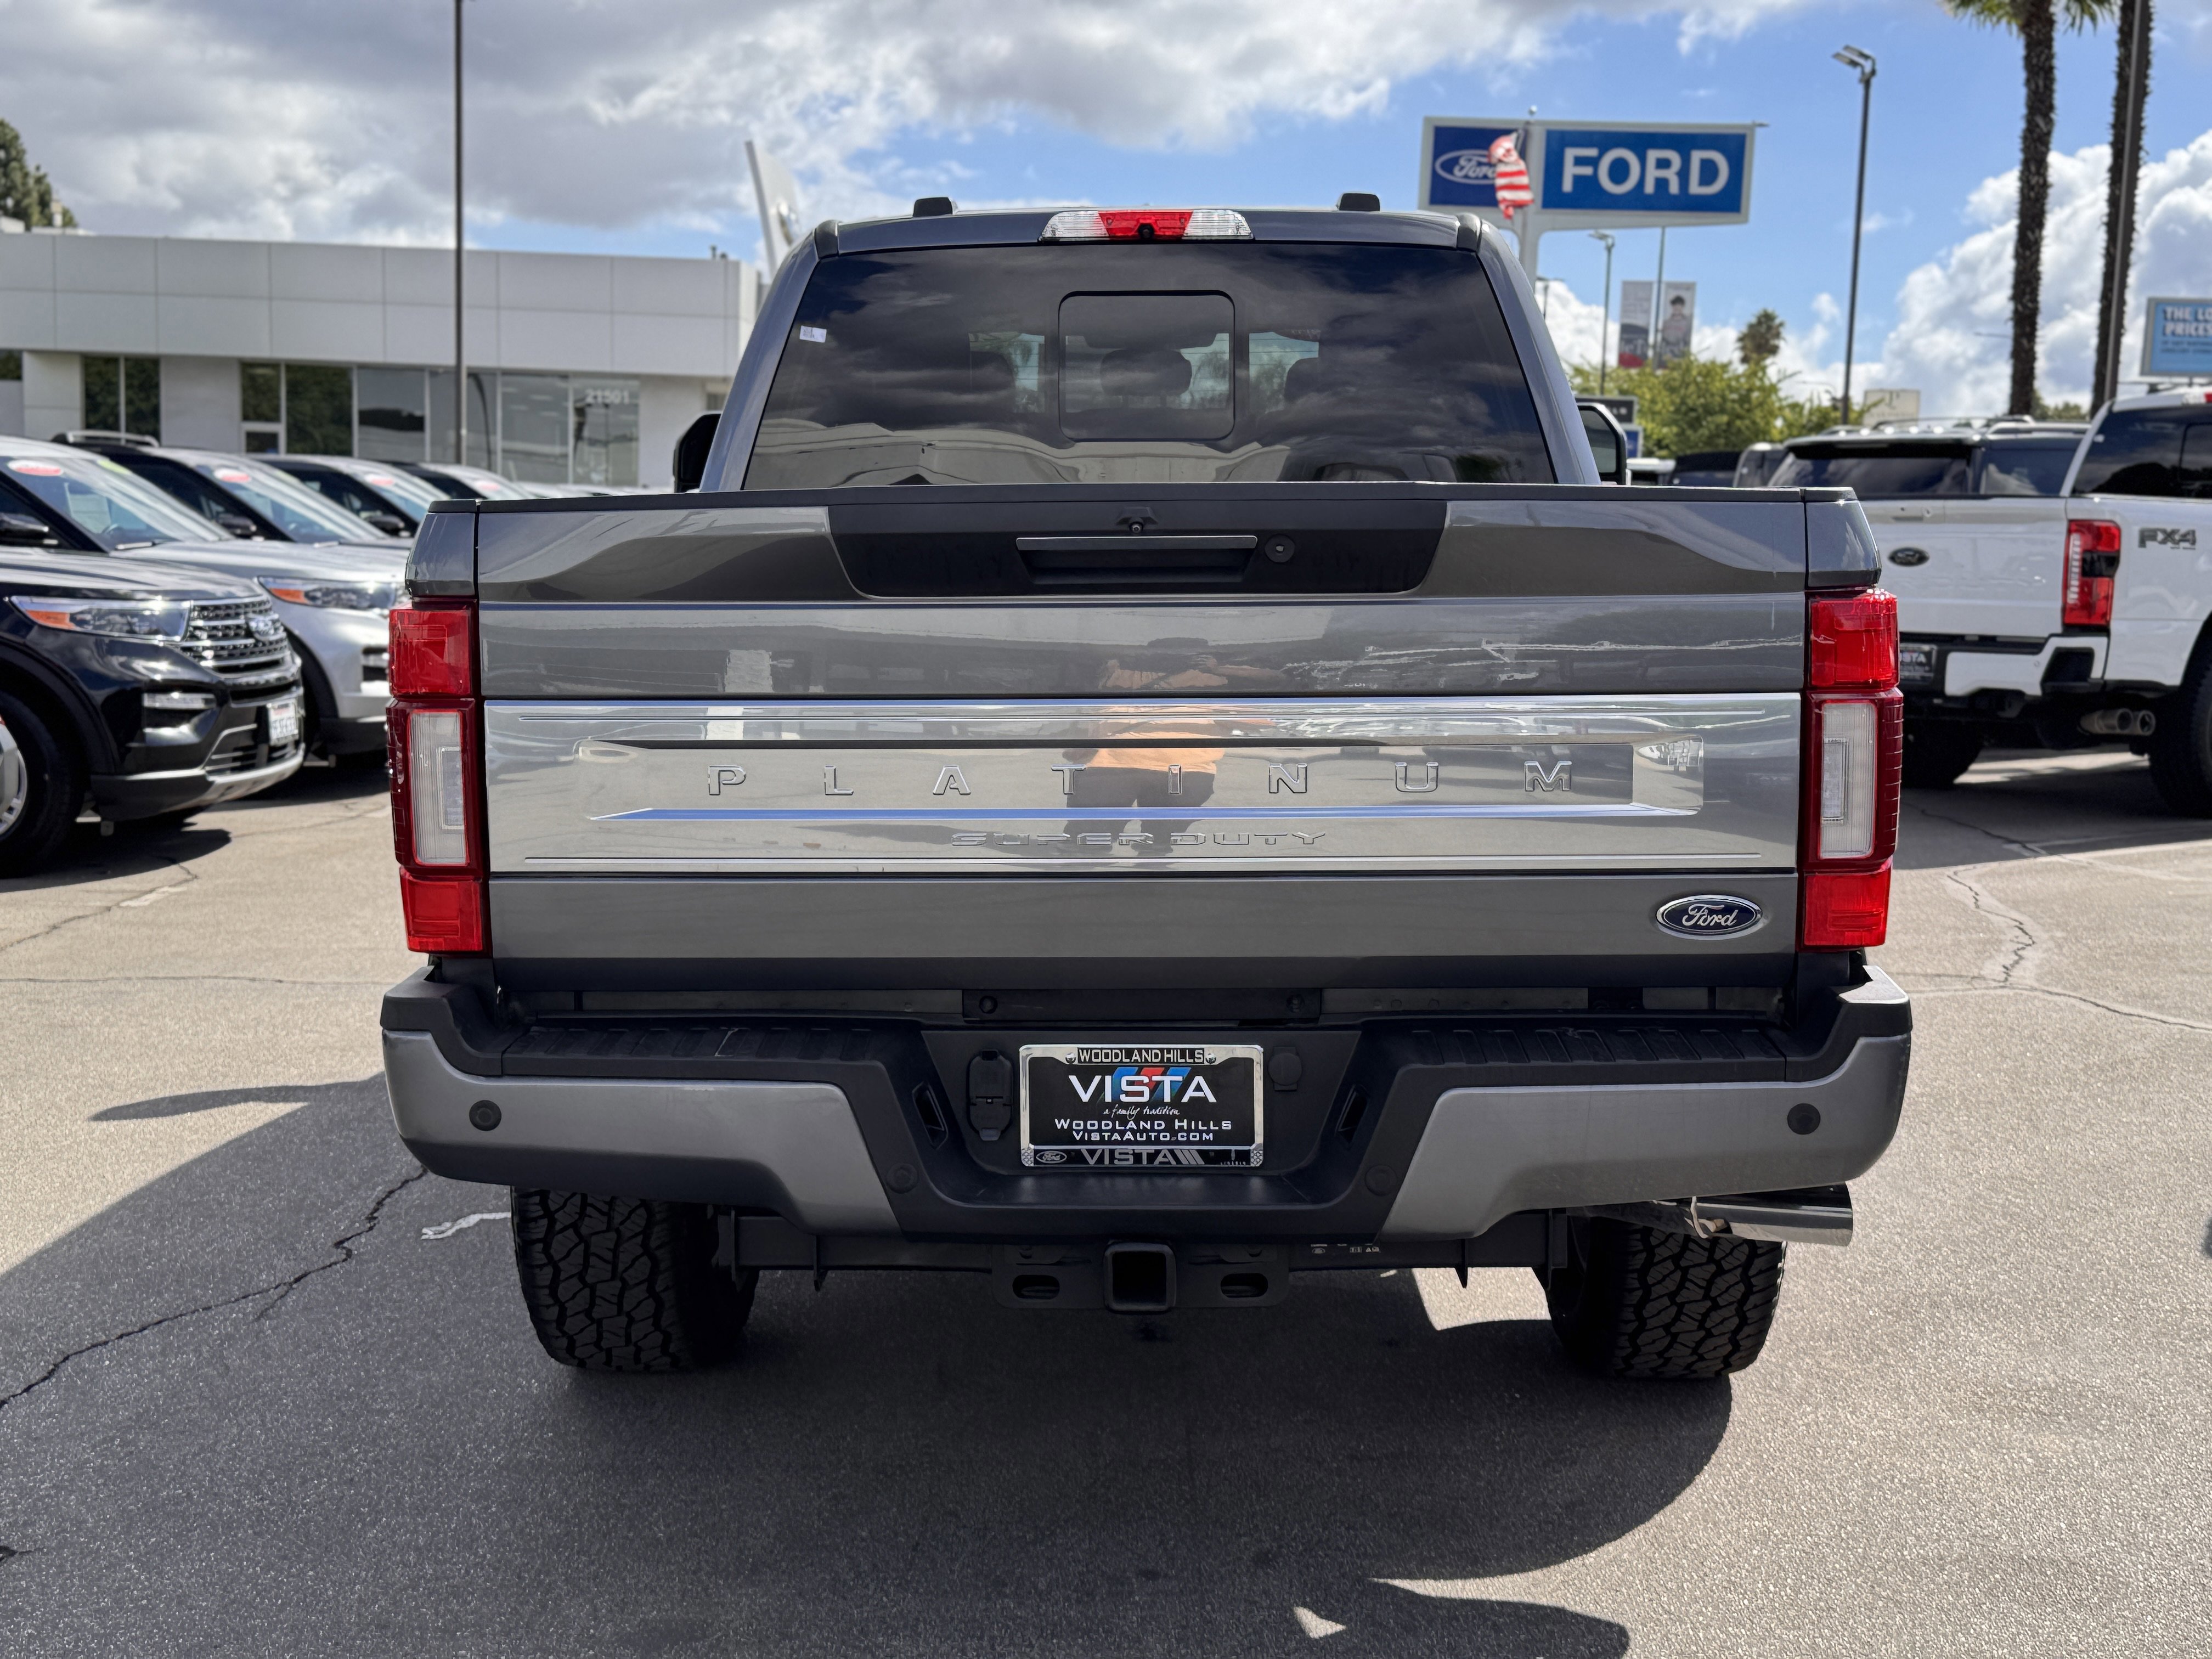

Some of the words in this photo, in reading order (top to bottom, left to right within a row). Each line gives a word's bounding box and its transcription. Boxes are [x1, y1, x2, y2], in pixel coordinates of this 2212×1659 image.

[1562, 146, 1730, 195] FORD
[2164, 307, 2192, 320] THE
[2138, 528, 2196, 548] FX4
[708, 760, 1572, 795] PLATINUM
[951, 832, 1154, 847] SUPER
[1170, 832, 1325, 846] DUTY
[1682, 904, 1739, 926] Ford
[1079, 1049, 1160, 1063] WOODLAND
[1164, 1049, 1204, 1063] HILLS
[1068, 1075, 1217, 1103] VISTA
[1054, 1119, 1165, 1130] WOODLAND
[1175, 1119, 1232, 1130] HILLS
[1081, 1149, 1176, 1165] VISTA
